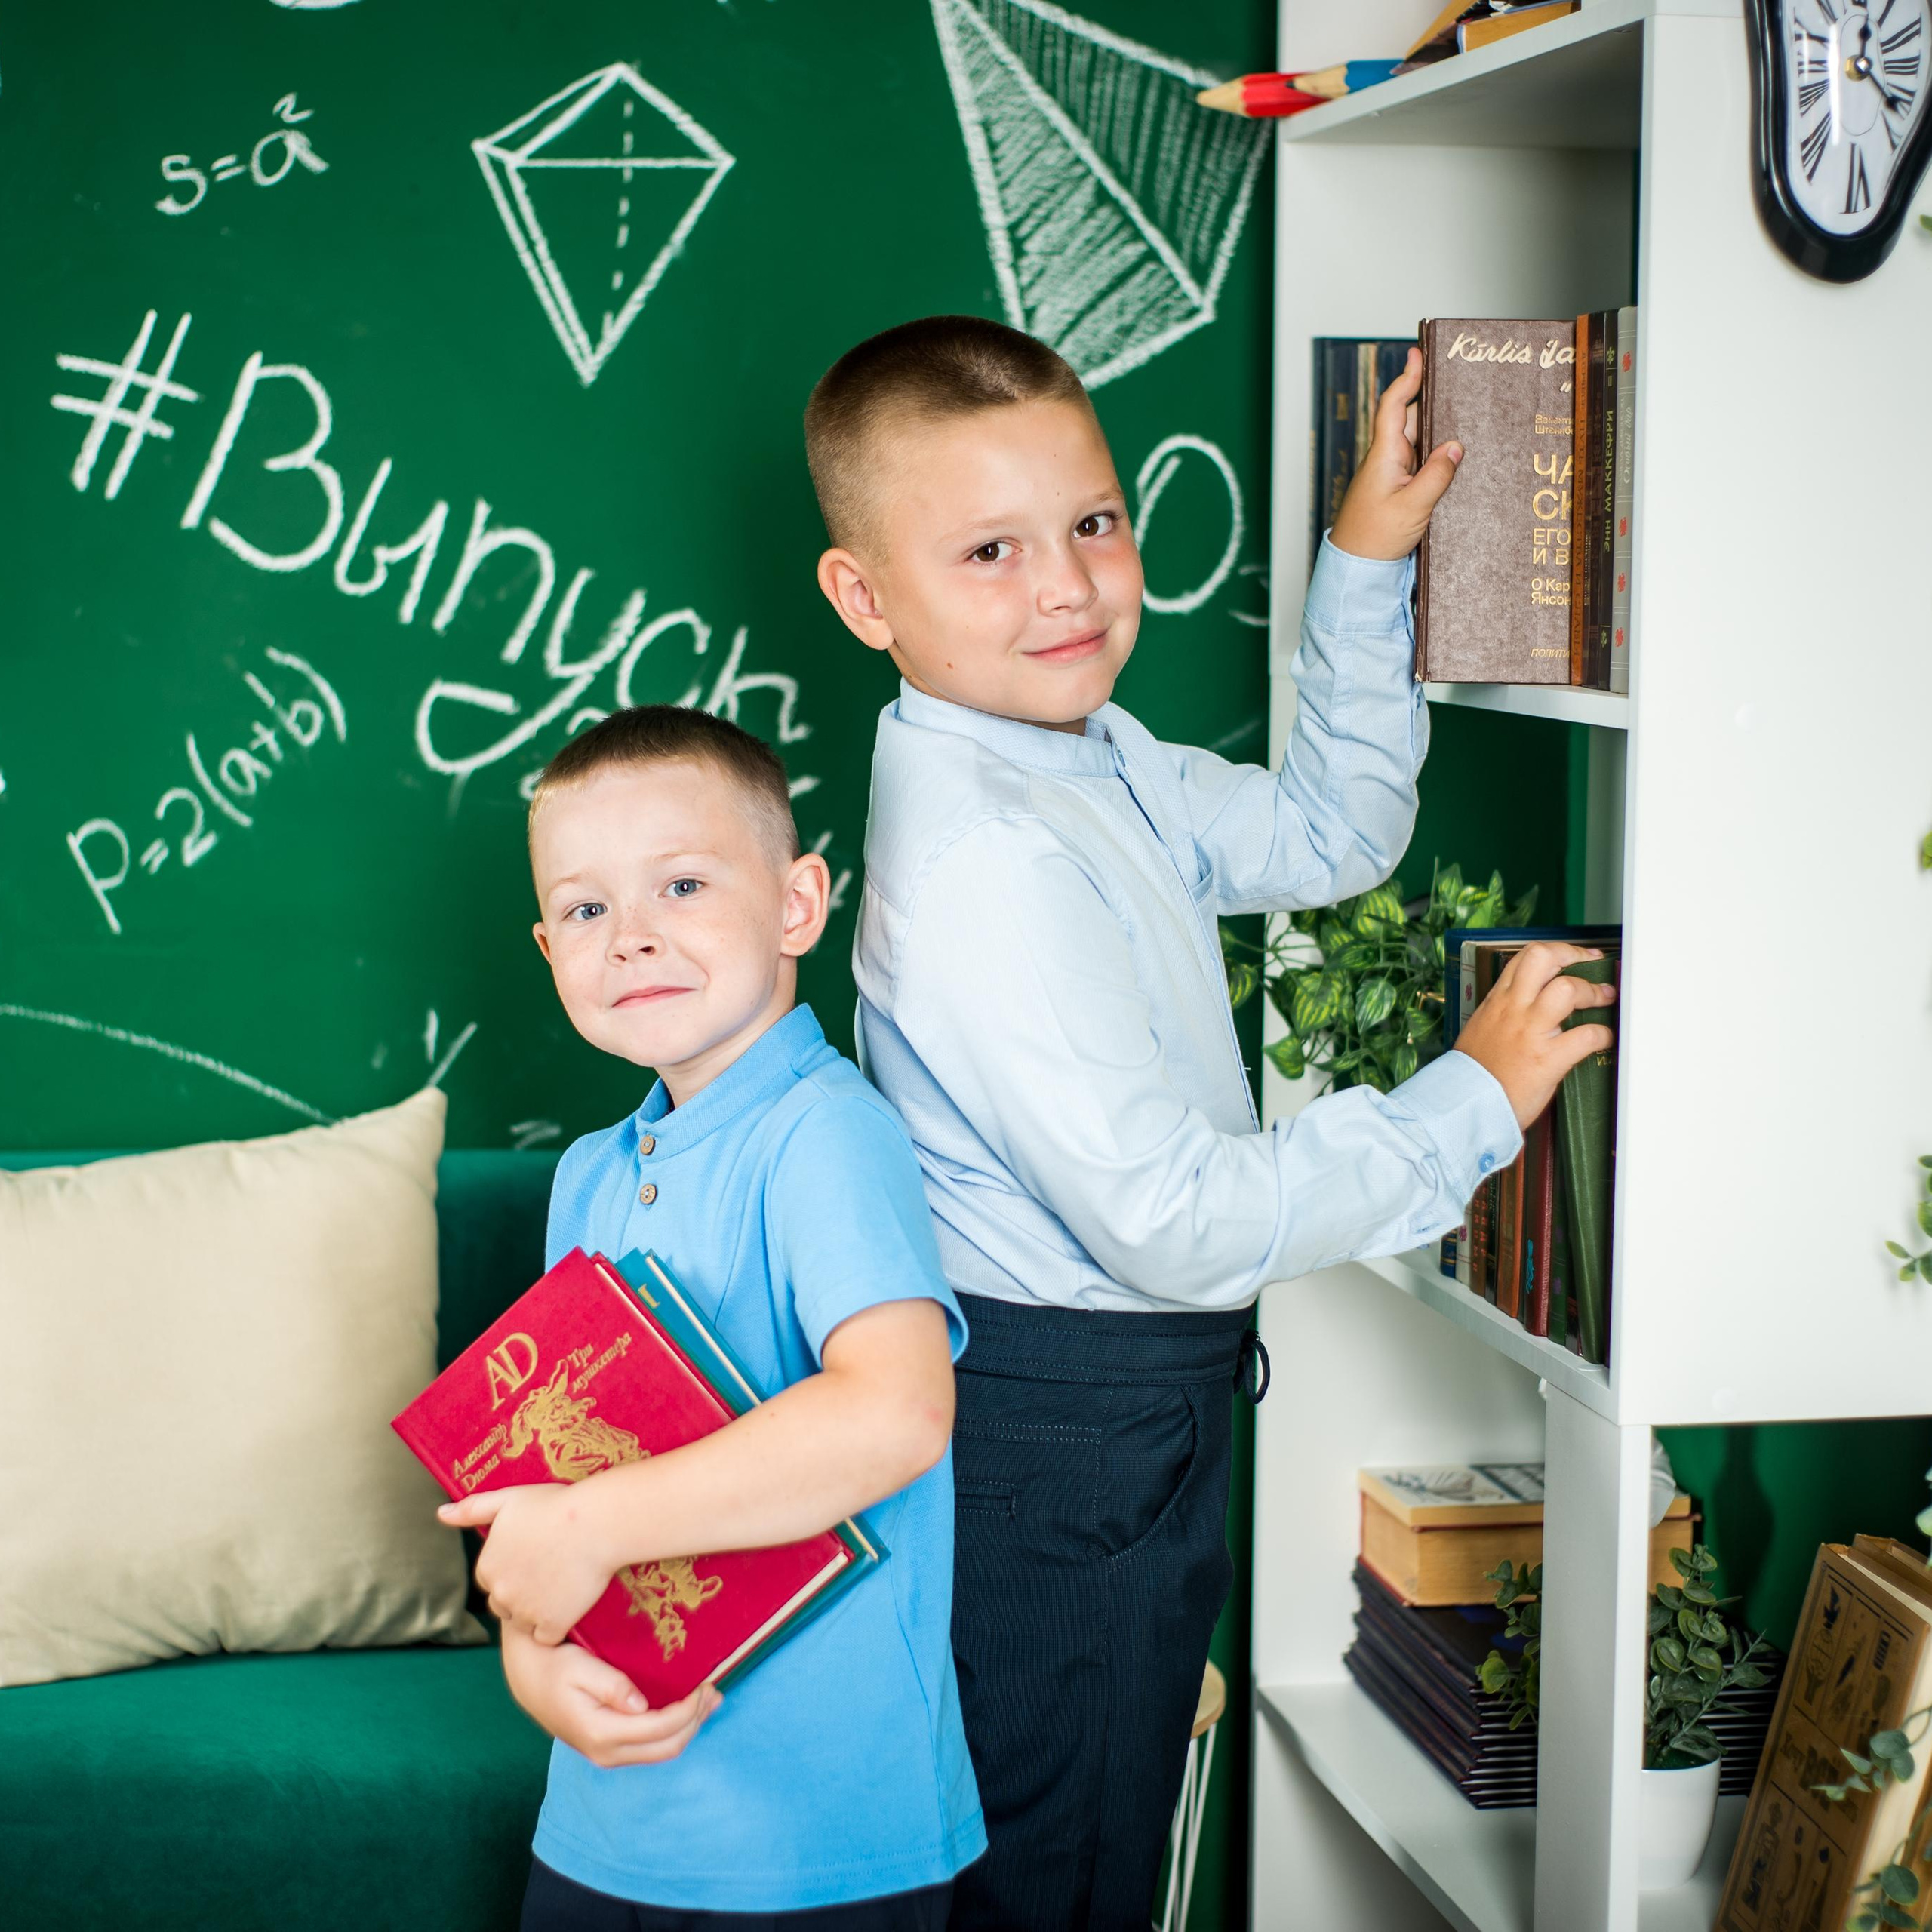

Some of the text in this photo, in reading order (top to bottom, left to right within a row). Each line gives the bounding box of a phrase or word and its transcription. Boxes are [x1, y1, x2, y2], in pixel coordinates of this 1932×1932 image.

[1604, 410, 1614, 512] МАККЕФРИ
[1533, 528, 1571, 546] ЕГО
[1532, 547, 1546, 565] И
[568, 1343, 595, 1369] Три
[485, 1331, 539, 1411] AD
